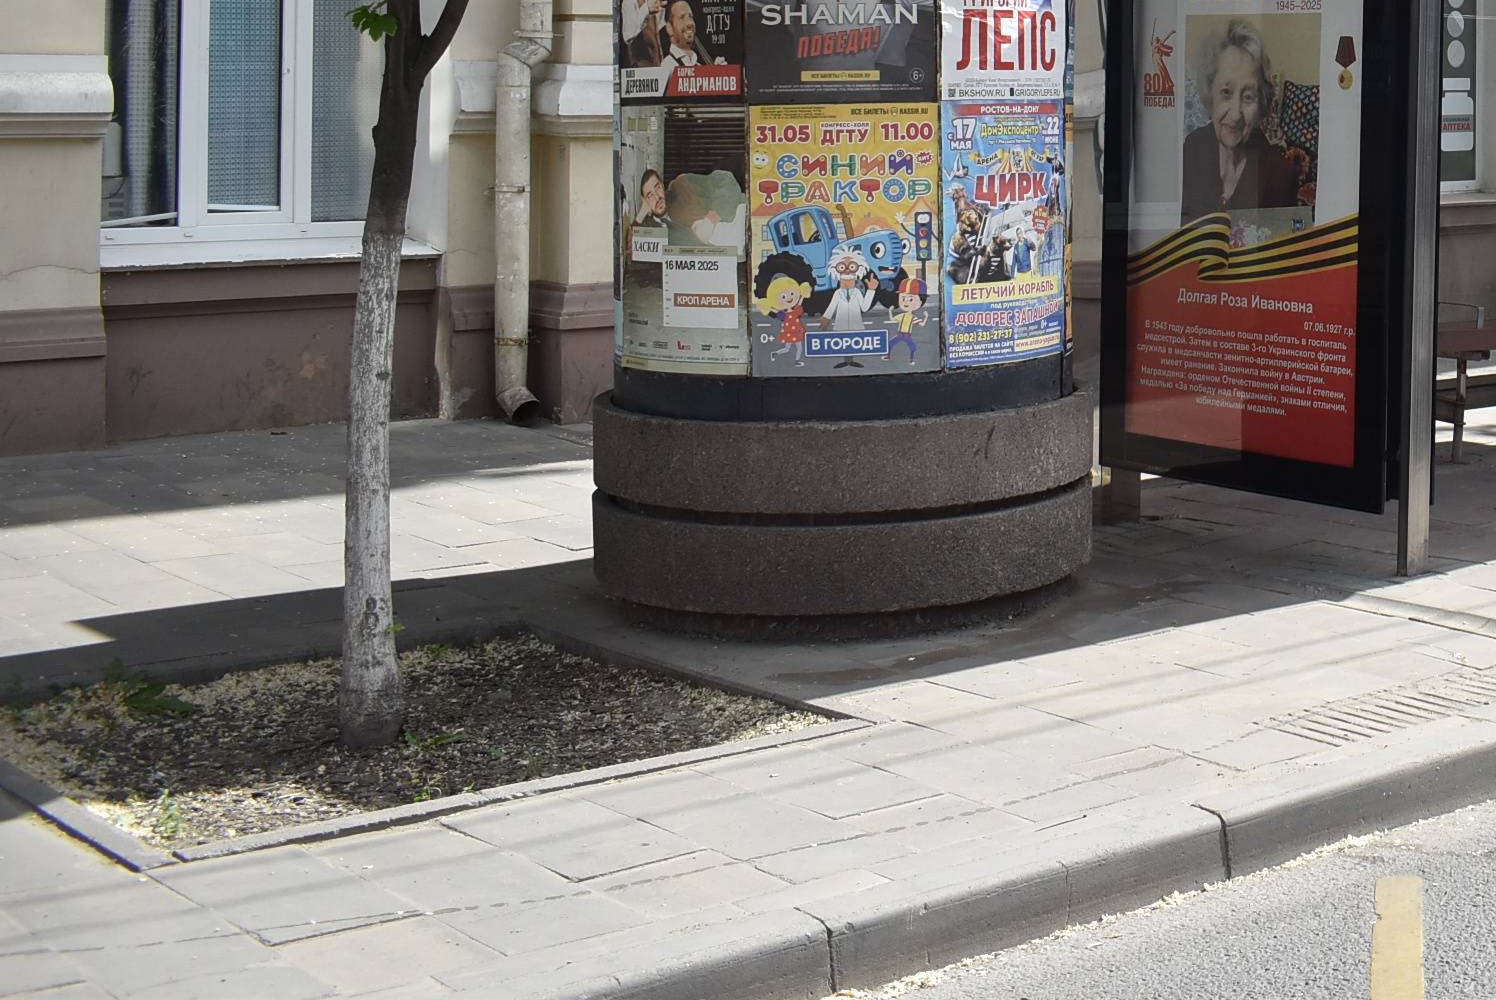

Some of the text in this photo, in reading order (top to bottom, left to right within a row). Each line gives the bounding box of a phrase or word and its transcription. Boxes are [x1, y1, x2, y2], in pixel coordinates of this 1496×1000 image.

[761, 3, 919, 25] SHAMAN
[706, 14, 730, 34] ДГТУ
[797, 25, 881, 58] ПОБЕДА!
[956, 9, 1056, 71] ЛЕПС
[677, 67, 695, 76] БОРИС
[625, 78, 659, 95] ДЕРЕВЯНКО
[677, 76, 737, 93] АНДРИАНОВ
[1144, 72, 1161, 92] 80
[959, 89, 1006, 97] BKSHOW.RU
[851, 108, 862, 116] ВСЕ
[980, 105, 1040, 114] РОСТОВ-НА-ДОНУ
[756, 124, 811, 144] 31.05
[881, 122, 934, 141] 11.00
[952, 118, 977, 140] 17
[1046, 116, 1060, 135] 22
[820, 128, 869, 146] ДГТУ
[950, 140, 973, 150] МАЯ
[776, 151, 914, 179] СИНИЙ
[758, 178, 932, 204] ТРАКТОР
[974, 172, 1048, 208] ЦИРК
[634, 241, 660, 253] ХАСКИ
[665, 261, 719, 271] 16 МАЯ 2025
[961, 280, 1054, 301] ЛЕТУЧИЙ КОРАБЛЬ
[677, 295, 730, 306] КРОП АРЕНА
[1177, 288, 1313, 314] Долгая Роза Ивановна
[955, 311, 1013, 327] ДОЛОРЕС
[760, 333, 775, 344] 0+
[811, 336, 881, 351] В ГОРОДЕ
[1169, 324, 1184, 334] году
[1185, 325, 1235, 338] добровольно
[1237, 331, 1263, 340] пошла
[1265, 333, 1300, 345] работать
[1308, 338, 1347, 350] госпиталь
[1189, 337, 1212, 348] Затем
[1268, 346, 1316, 358] Украинского
[1317, 351, 1347, 363] фронта
[1218, 363, 1259, 375] Закончила
[1260, 369, 1283, 380] войну
[1291, 372, 1325, 385] Австрии.
[1189, 384, 1216, 395] победу
[1217, 389, 1232, 397] над
[1280, 396, 1312, 407] знаками
[1280, 384, 1305, 394] войны
